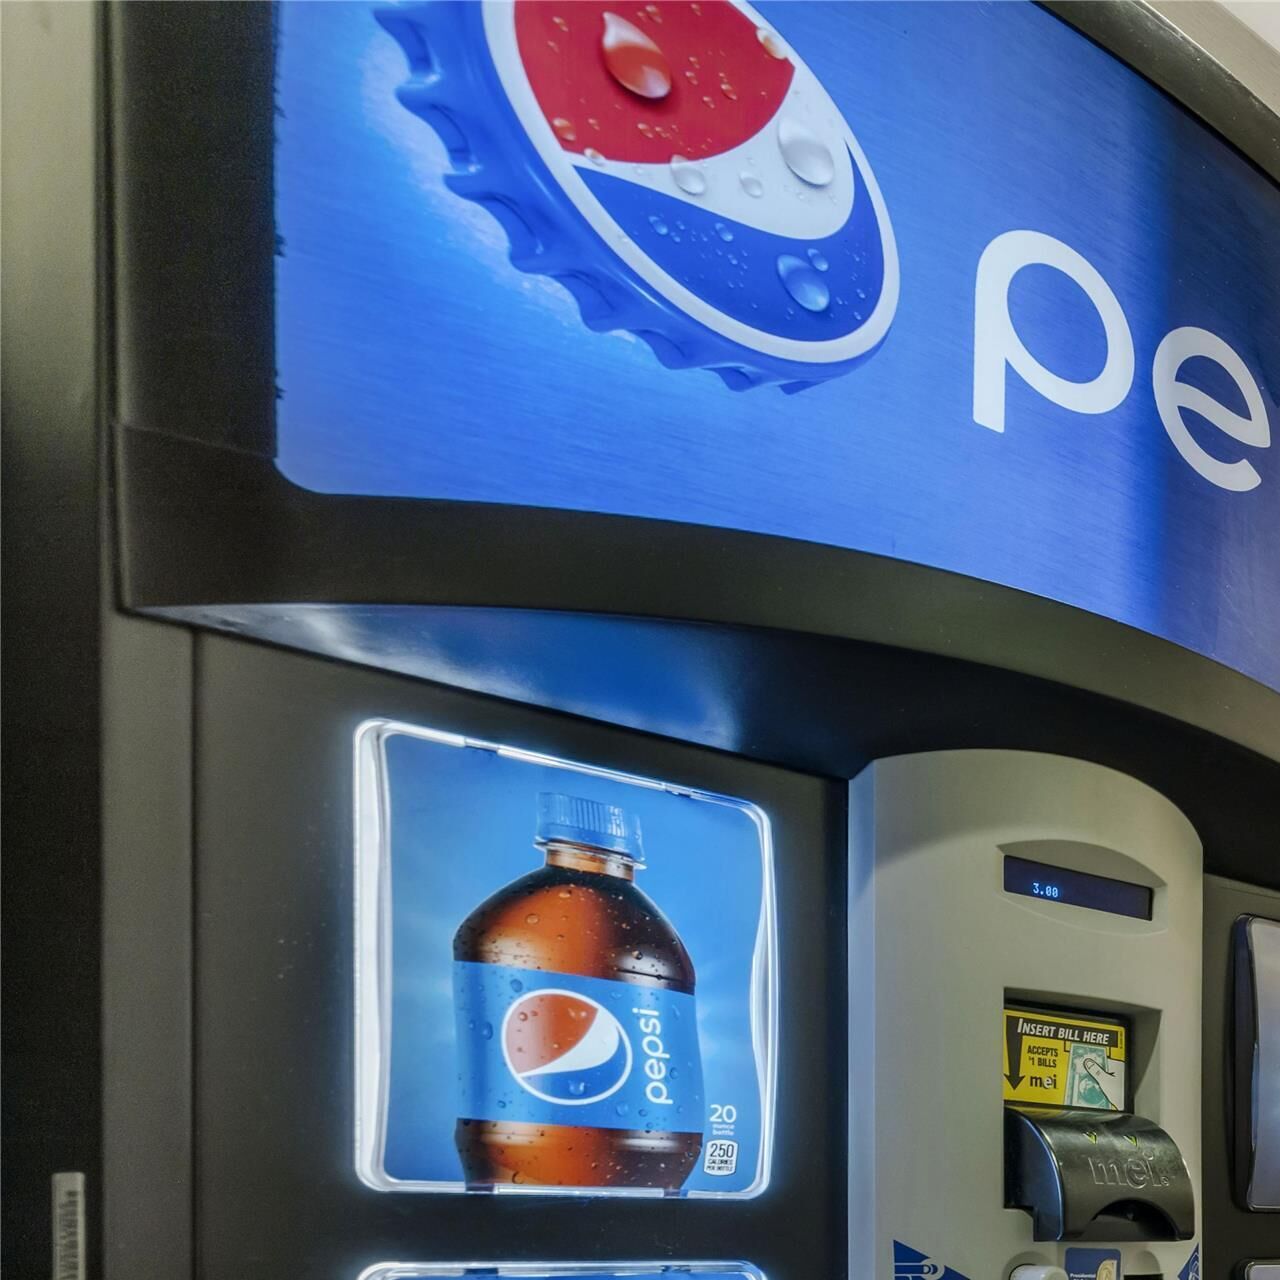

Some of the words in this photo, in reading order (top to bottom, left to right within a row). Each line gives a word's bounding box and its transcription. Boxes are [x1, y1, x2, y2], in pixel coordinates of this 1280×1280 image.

[1032, 882, 1059, 898] 3.00
[1017, 1018, 1056, 1038] INSERT
[1058, 1028, 1080, 1041] BILL
[1082, 1031, 1110, 1045] HERE
[632, 1007, 673, 1104] pepsi
[1027, 1045, 1058, 1057] ACCEPTS
[1037, 1058, 1057, 1068] BILLS
[1029, 1074, 1057, 1089] mei
[709, 1104, 737, 1123] 20
[710, 1143, 735, 1158] 250
